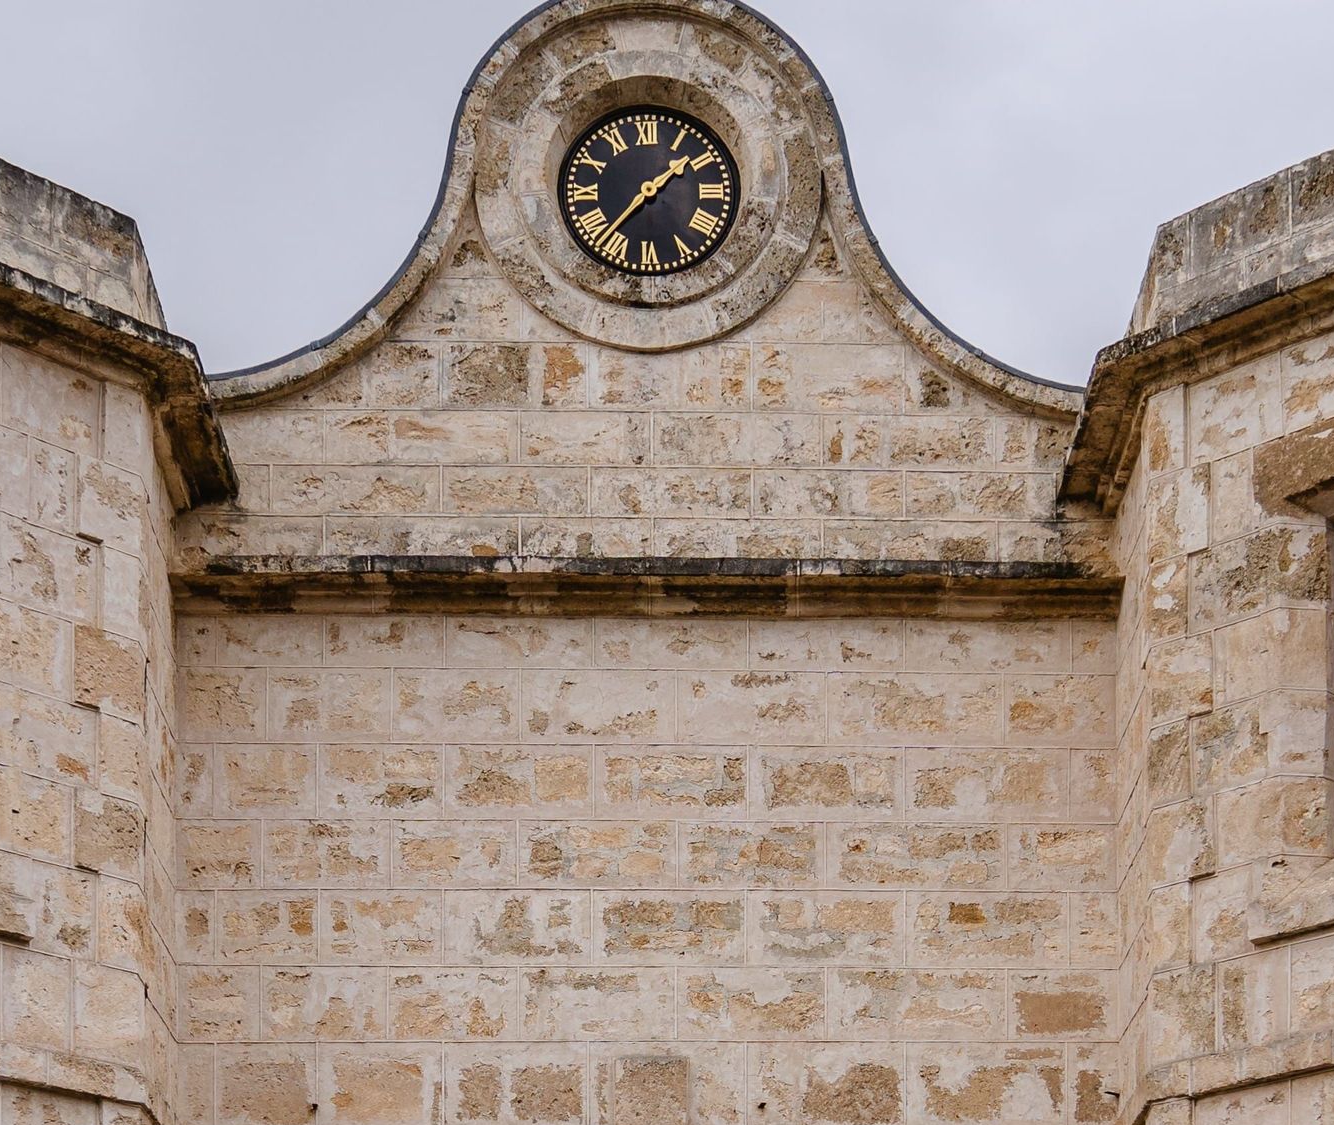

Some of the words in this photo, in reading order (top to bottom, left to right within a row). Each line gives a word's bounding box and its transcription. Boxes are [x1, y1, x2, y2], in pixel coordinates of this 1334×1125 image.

[602, 128, 629, 156] XI
[635, 121, 658, 145] XII
[580, 152, 607, 174] X
[689, 151, 715, 172] II
[573, 183, 598, 201] IX
[699, 183, 724, 200] III
[688, 207, 719, 236] IIII
[602, 231, 629, 260] VII
[641, 241, 659, 265] VI
[673, 234, 692, 257] V
